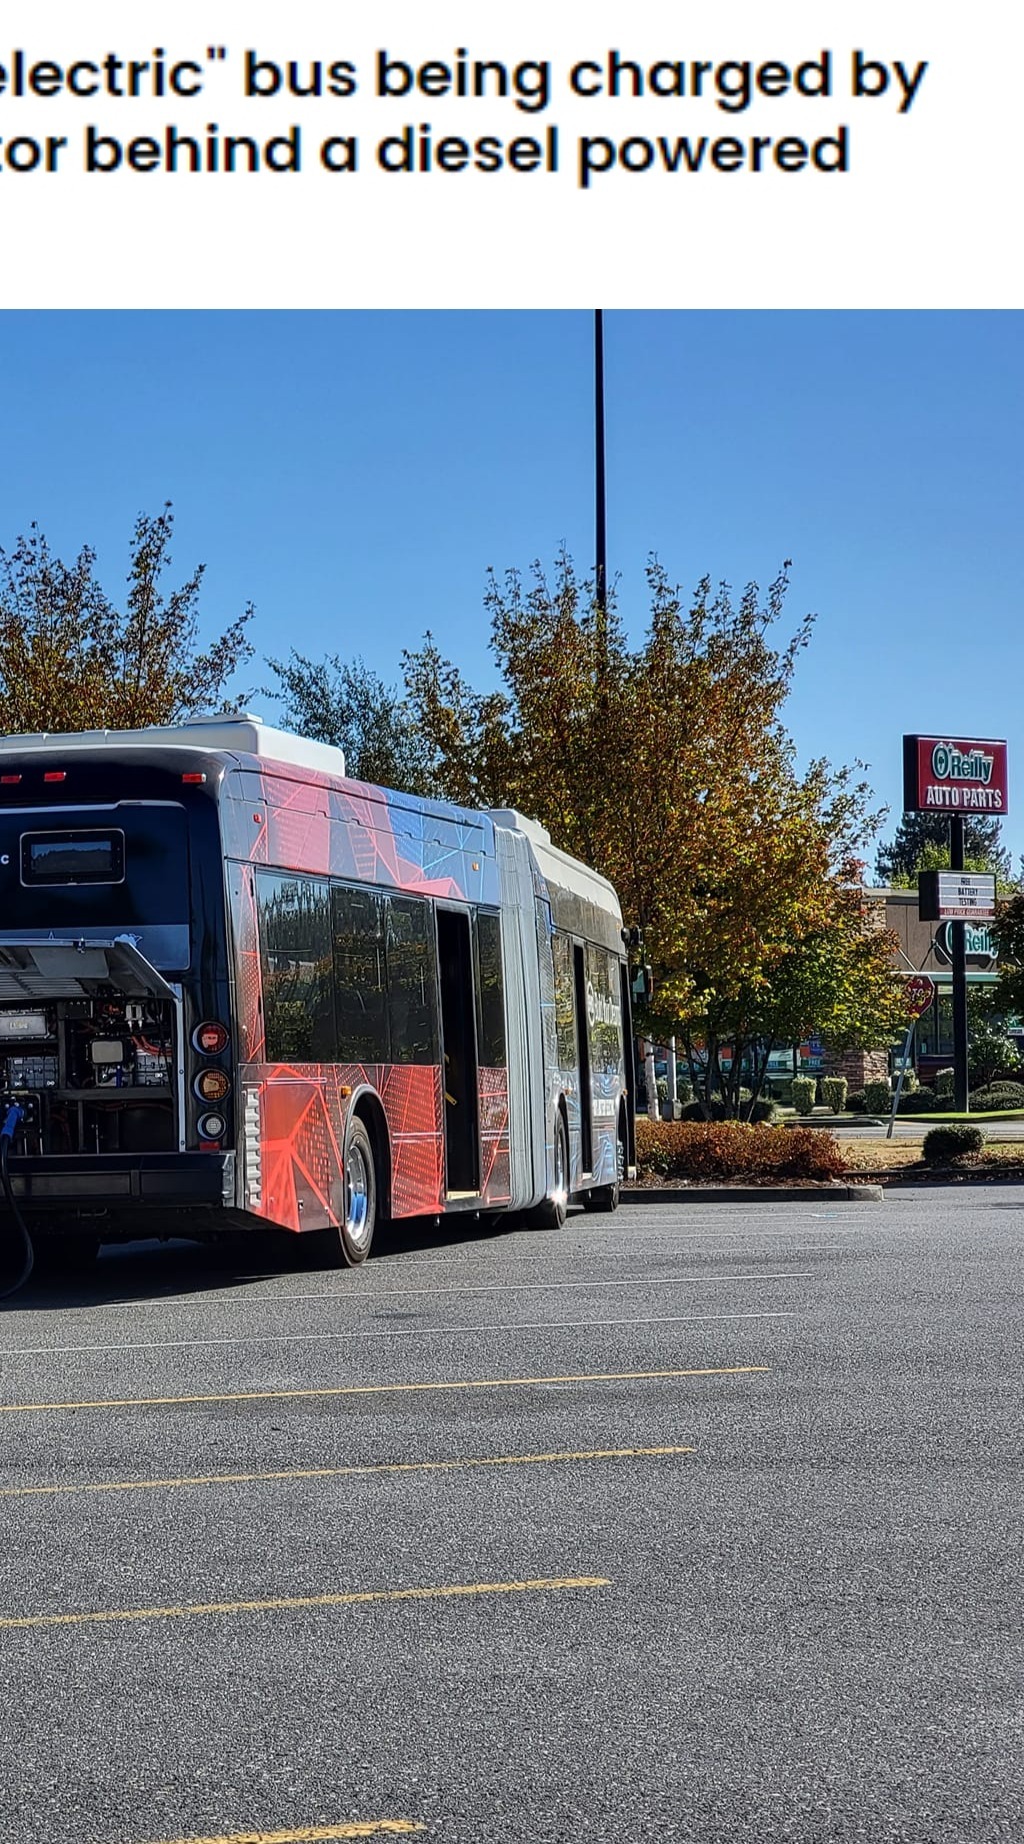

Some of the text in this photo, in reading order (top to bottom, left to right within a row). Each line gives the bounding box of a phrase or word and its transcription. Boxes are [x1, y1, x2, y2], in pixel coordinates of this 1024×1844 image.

[933, 742, 994, 784] O'Reilly
[927, 786, 1002, 808] AUTO PARTS
[957, 887, 978, 896] BATTERY
[959, 897, 977, 906] TESTING
